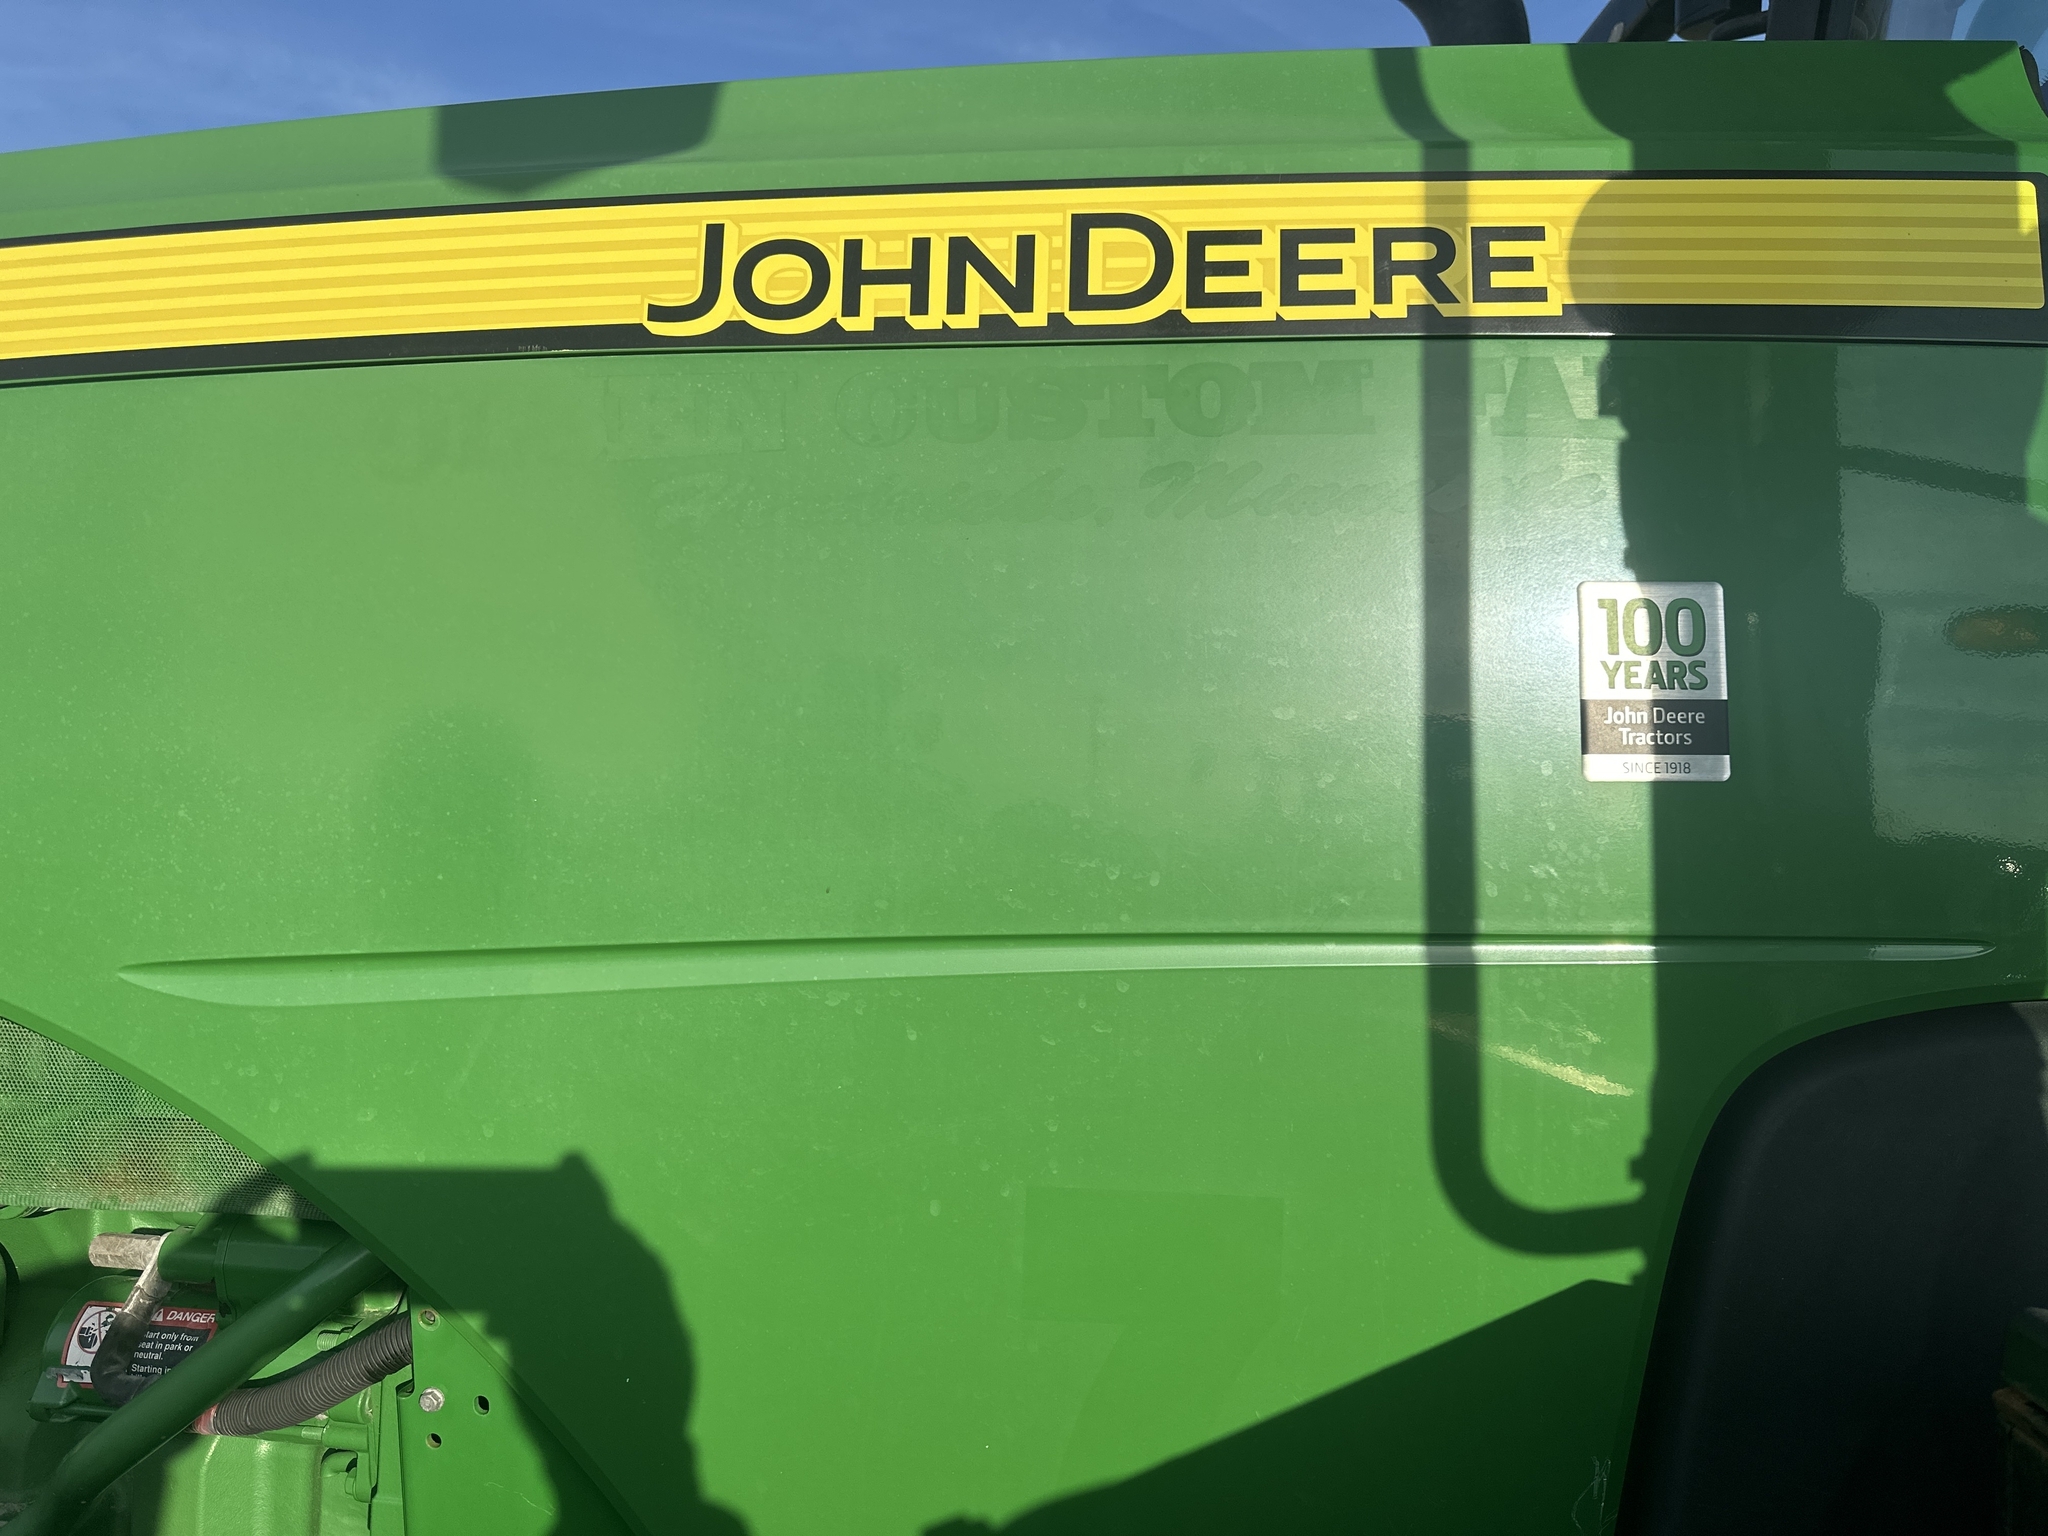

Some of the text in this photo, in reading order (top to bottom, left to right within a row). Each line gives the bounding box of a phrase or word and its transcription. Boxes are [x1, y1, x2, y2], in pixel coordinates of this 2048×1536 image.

[646, 211, 1549, 322] JOHN DEERE
[1597, 597, 1707, 657] 100
[1600, 660, 1709, 691] YEARS
[1603, 705, 1706, 725] John Deere
[1618, 727, 1693, 746] Tractors
[1622, 761, 1692, 775] SINCE 1918
[143, 1330, 160, 1340] tart
[160, 1331, 179, 1342] only
[133, 1351, 164, 1361] neutral.
[154, 1341, 163, 1350] in
[163, 1342, 183, 1352] park
[183, 1344, 194, 1352] or
